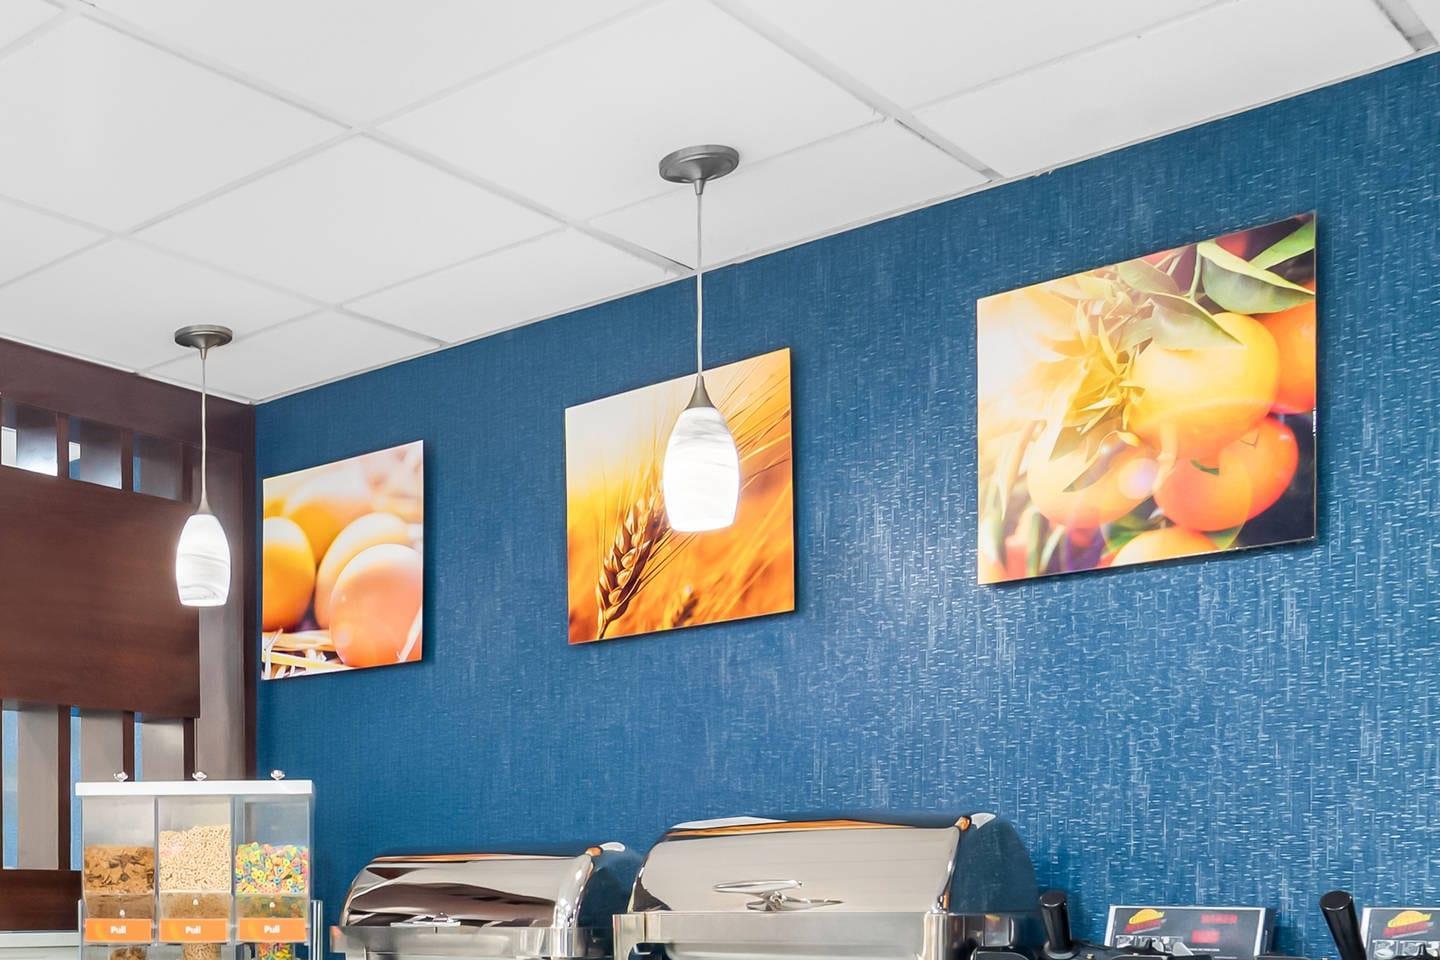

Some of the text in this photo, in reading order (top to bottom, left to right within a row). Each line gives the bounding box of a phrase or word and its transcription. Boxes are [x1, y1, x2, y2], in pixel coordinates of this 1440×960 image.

[110, 925, 127, 934] Pull
[185, 925, 201, 934] Pull
[264, 925, 281, 934] Pull
